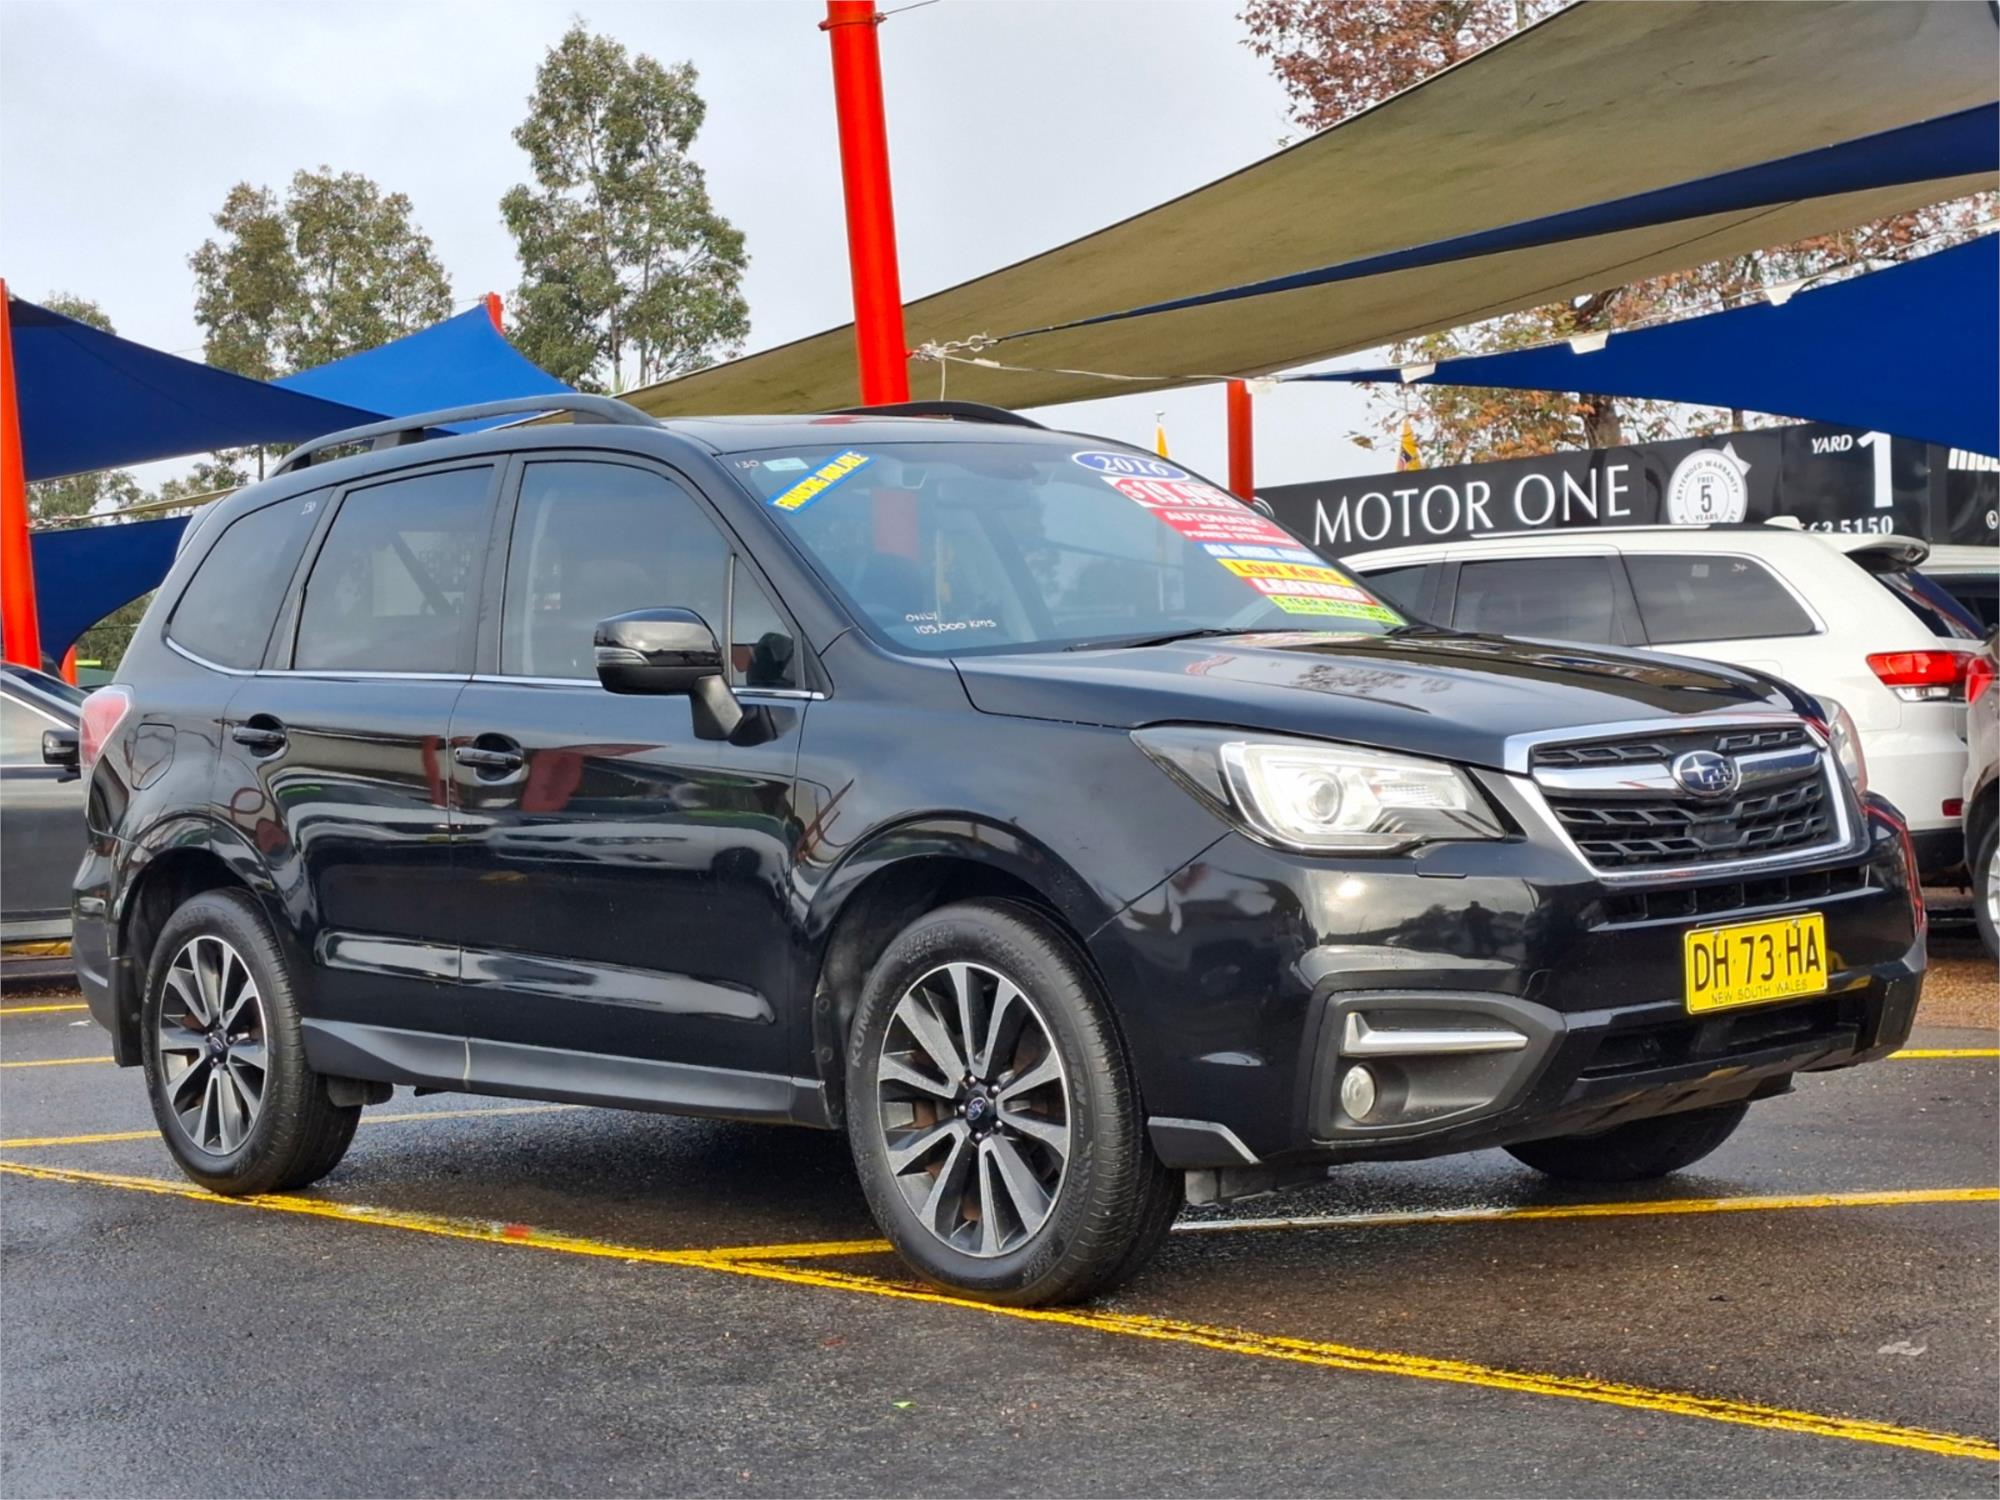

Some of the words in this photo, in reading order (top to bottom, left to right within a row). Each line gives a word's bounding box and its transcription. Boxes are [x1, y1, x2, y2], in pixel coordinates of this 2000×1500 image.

[1093, 455, 1169, 476] 2016
[1811, 434, 1852, 454] YARD
[1857, 430, 1893, 508] 1
[1676, 461, 1703, 500] EXTENDED
[1704, 460, 1738, 493] WARRANTY
[1313, 480, 1494, 546] MOTOR
[1514, 464, 1631, 526] ONE
[1701, 484, 1712, 513] 5
[1840, 515, 1894, 535] 5150
[1250, 577, 1375, 605] LEATHER
[1711, 990, 1733, 1005] NEW
[1738, 985, 1771, 1001] SOUTH
[1776, 979, 1808, 993] WALES
